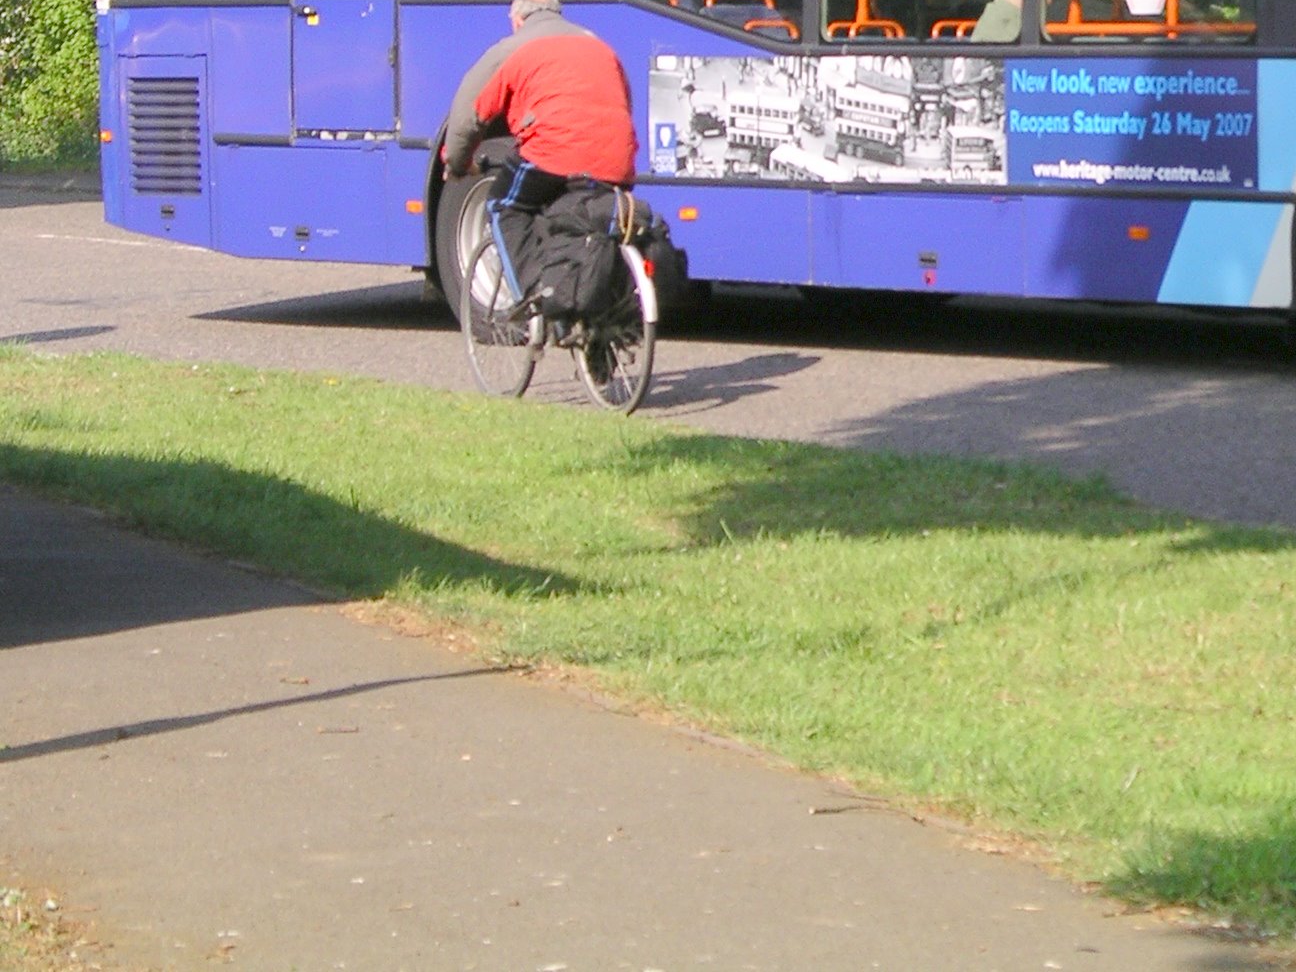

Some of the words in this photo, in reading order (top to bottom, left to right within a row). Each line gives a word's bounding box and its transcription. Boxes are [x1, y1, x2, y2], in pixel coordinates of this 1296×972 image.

[1011, 69, 1048, 93] New
[1051, 68, 1095, 96] look,
[1098, 74, 1130, 93] new
[1009, 109, 1069, 137] Reopens
[1072, 109, 1147, 140] Saturday
[1151, 112, 1171, 135] 26
[1176, 112, 1211, 141] May
[1214, 113, 1253, 136] 2007
[1032, 159, 1232, 185] www.heritage-motor-centre.co.uk
